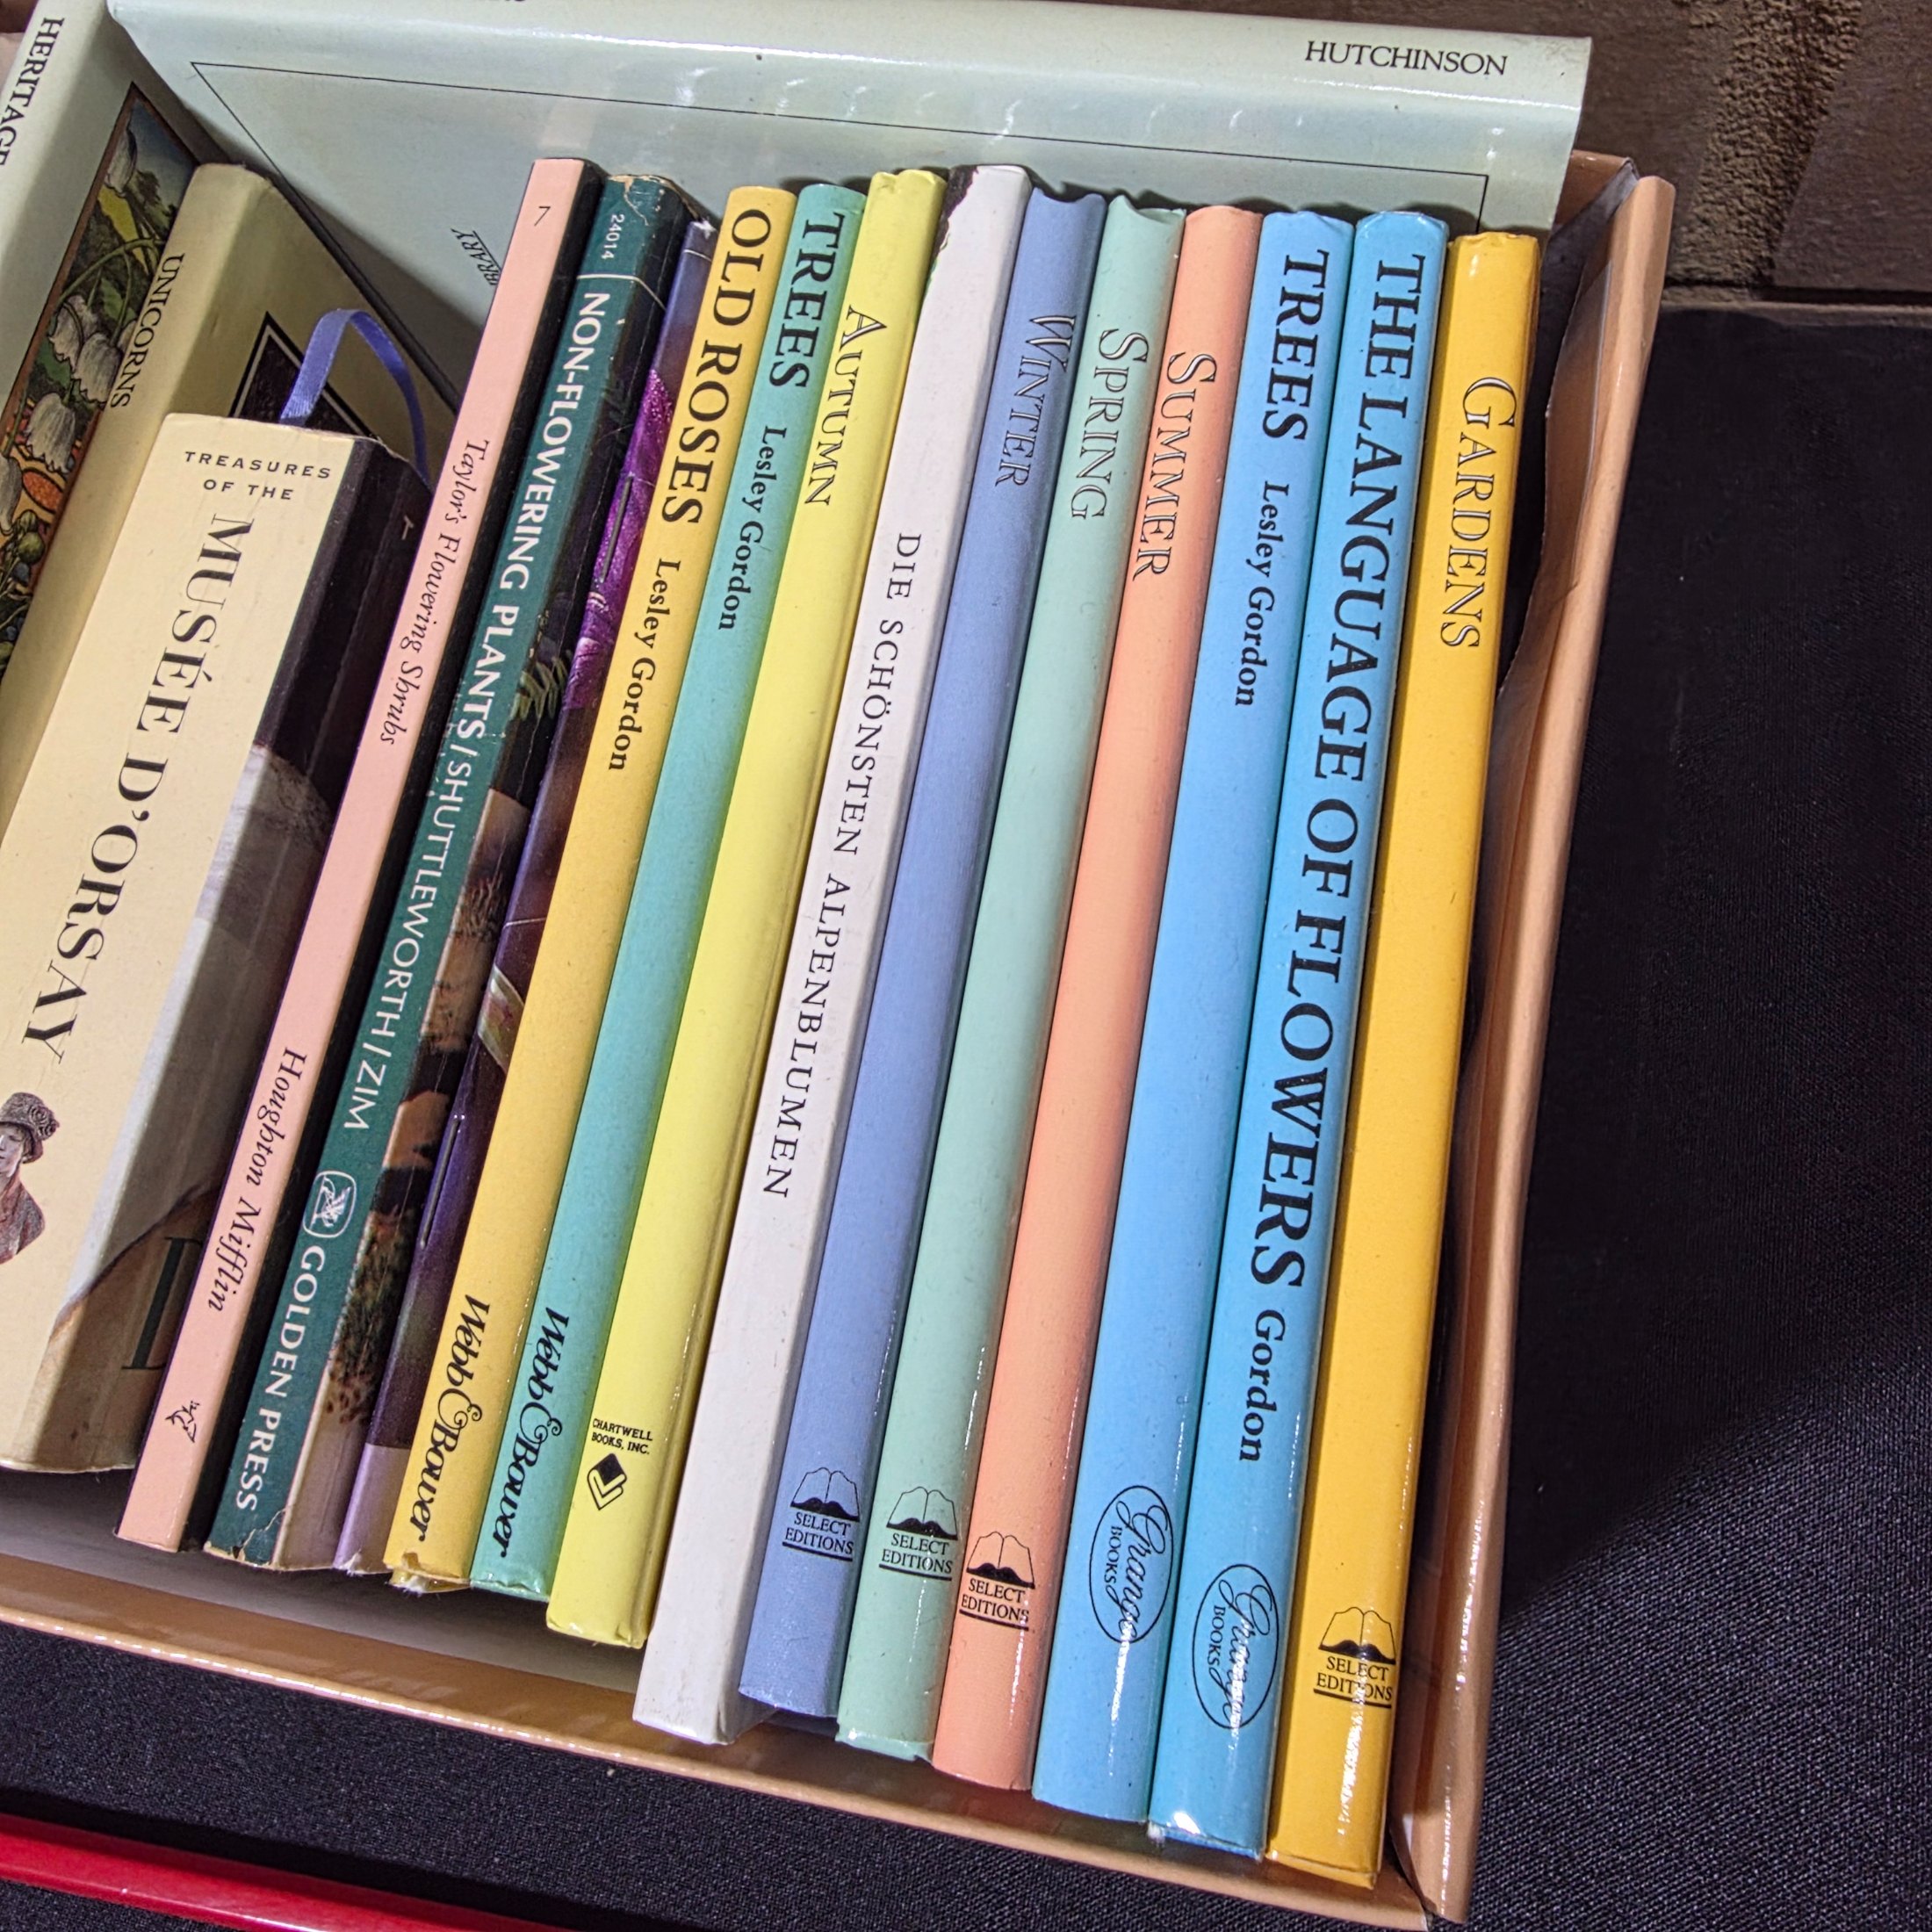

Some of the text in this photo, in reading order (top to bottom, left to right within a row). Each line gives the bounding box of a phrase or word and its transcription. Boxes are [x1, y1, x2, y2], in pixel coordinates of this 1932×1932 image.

[1305, 40, 1508, 76] HUTCHINSON
[534, 205, 551, 227] 7
[601, 213, 625, 260] 24014
[110, 253, 184, 408] UNICORNS
[499, 292, 611, 590] NON-FLOWERING
[717, 212, 844, 631] TREES Lesley Gordon
[804, 305, 887, 507] AUTUMN
[995, 314, 1076, 487] WINTER
[1071, 328, 1150, 520] SPRING
[184, 451, 332, 479] TREASURES
[203, 478, 294, 501] OF THE
[609, 208, 772, 772] OLD ROSES Lesley Gordon
[1132, 352, 1217, 580] SUMMER
[1236, 249, 1330, 706] TREES Lesley Gordon
[1439, 378, 1517, 648] GARDENS
[380, 438, 489, 746] Taylor's Flowering Shrubs
[22, 514, 255, 1064] MUSÉE D'ORSAY
[767, 533, 920, 1198] DIE SCHÖNSTEN ALPENBLUMEN
[1238, 255, 1425, 1461] THE LANGUAGE OF FLOWERS Gordon
[343, 1060, 386, 1130] ZIM
[208, 1048, 307, 1311] Houghton Mifflin
[235, 1244, 326, 1511] GOLDEN PRESS
[446, 1294, 490, 1387] Webb
[529, 1307, 569, 1400] Webb
[591, 1432, 651, 1455] BOOKS, INC.
[592, 1418, 653, 1441] CHARTWELL
[785, 1527, 854, 1554] EDITIONS
[793, 1512, 851, 1536] SELECT
[881, 1548, 953, 1575] EDITIONS
[890, 1532, 949, 1557] SELECT
[1104, 1525, 1122, 1584] BOOKS
[962, 1595, 1029, 1623] EDITIONS
[968, 1579, 1026, 1603] SELECT
[1208, 1605, 1226, 1666] BOOKS
[1325, 1656, 1389, 1681] SELECT
[1316, 1673, 1392, 1700] EDITIONS
